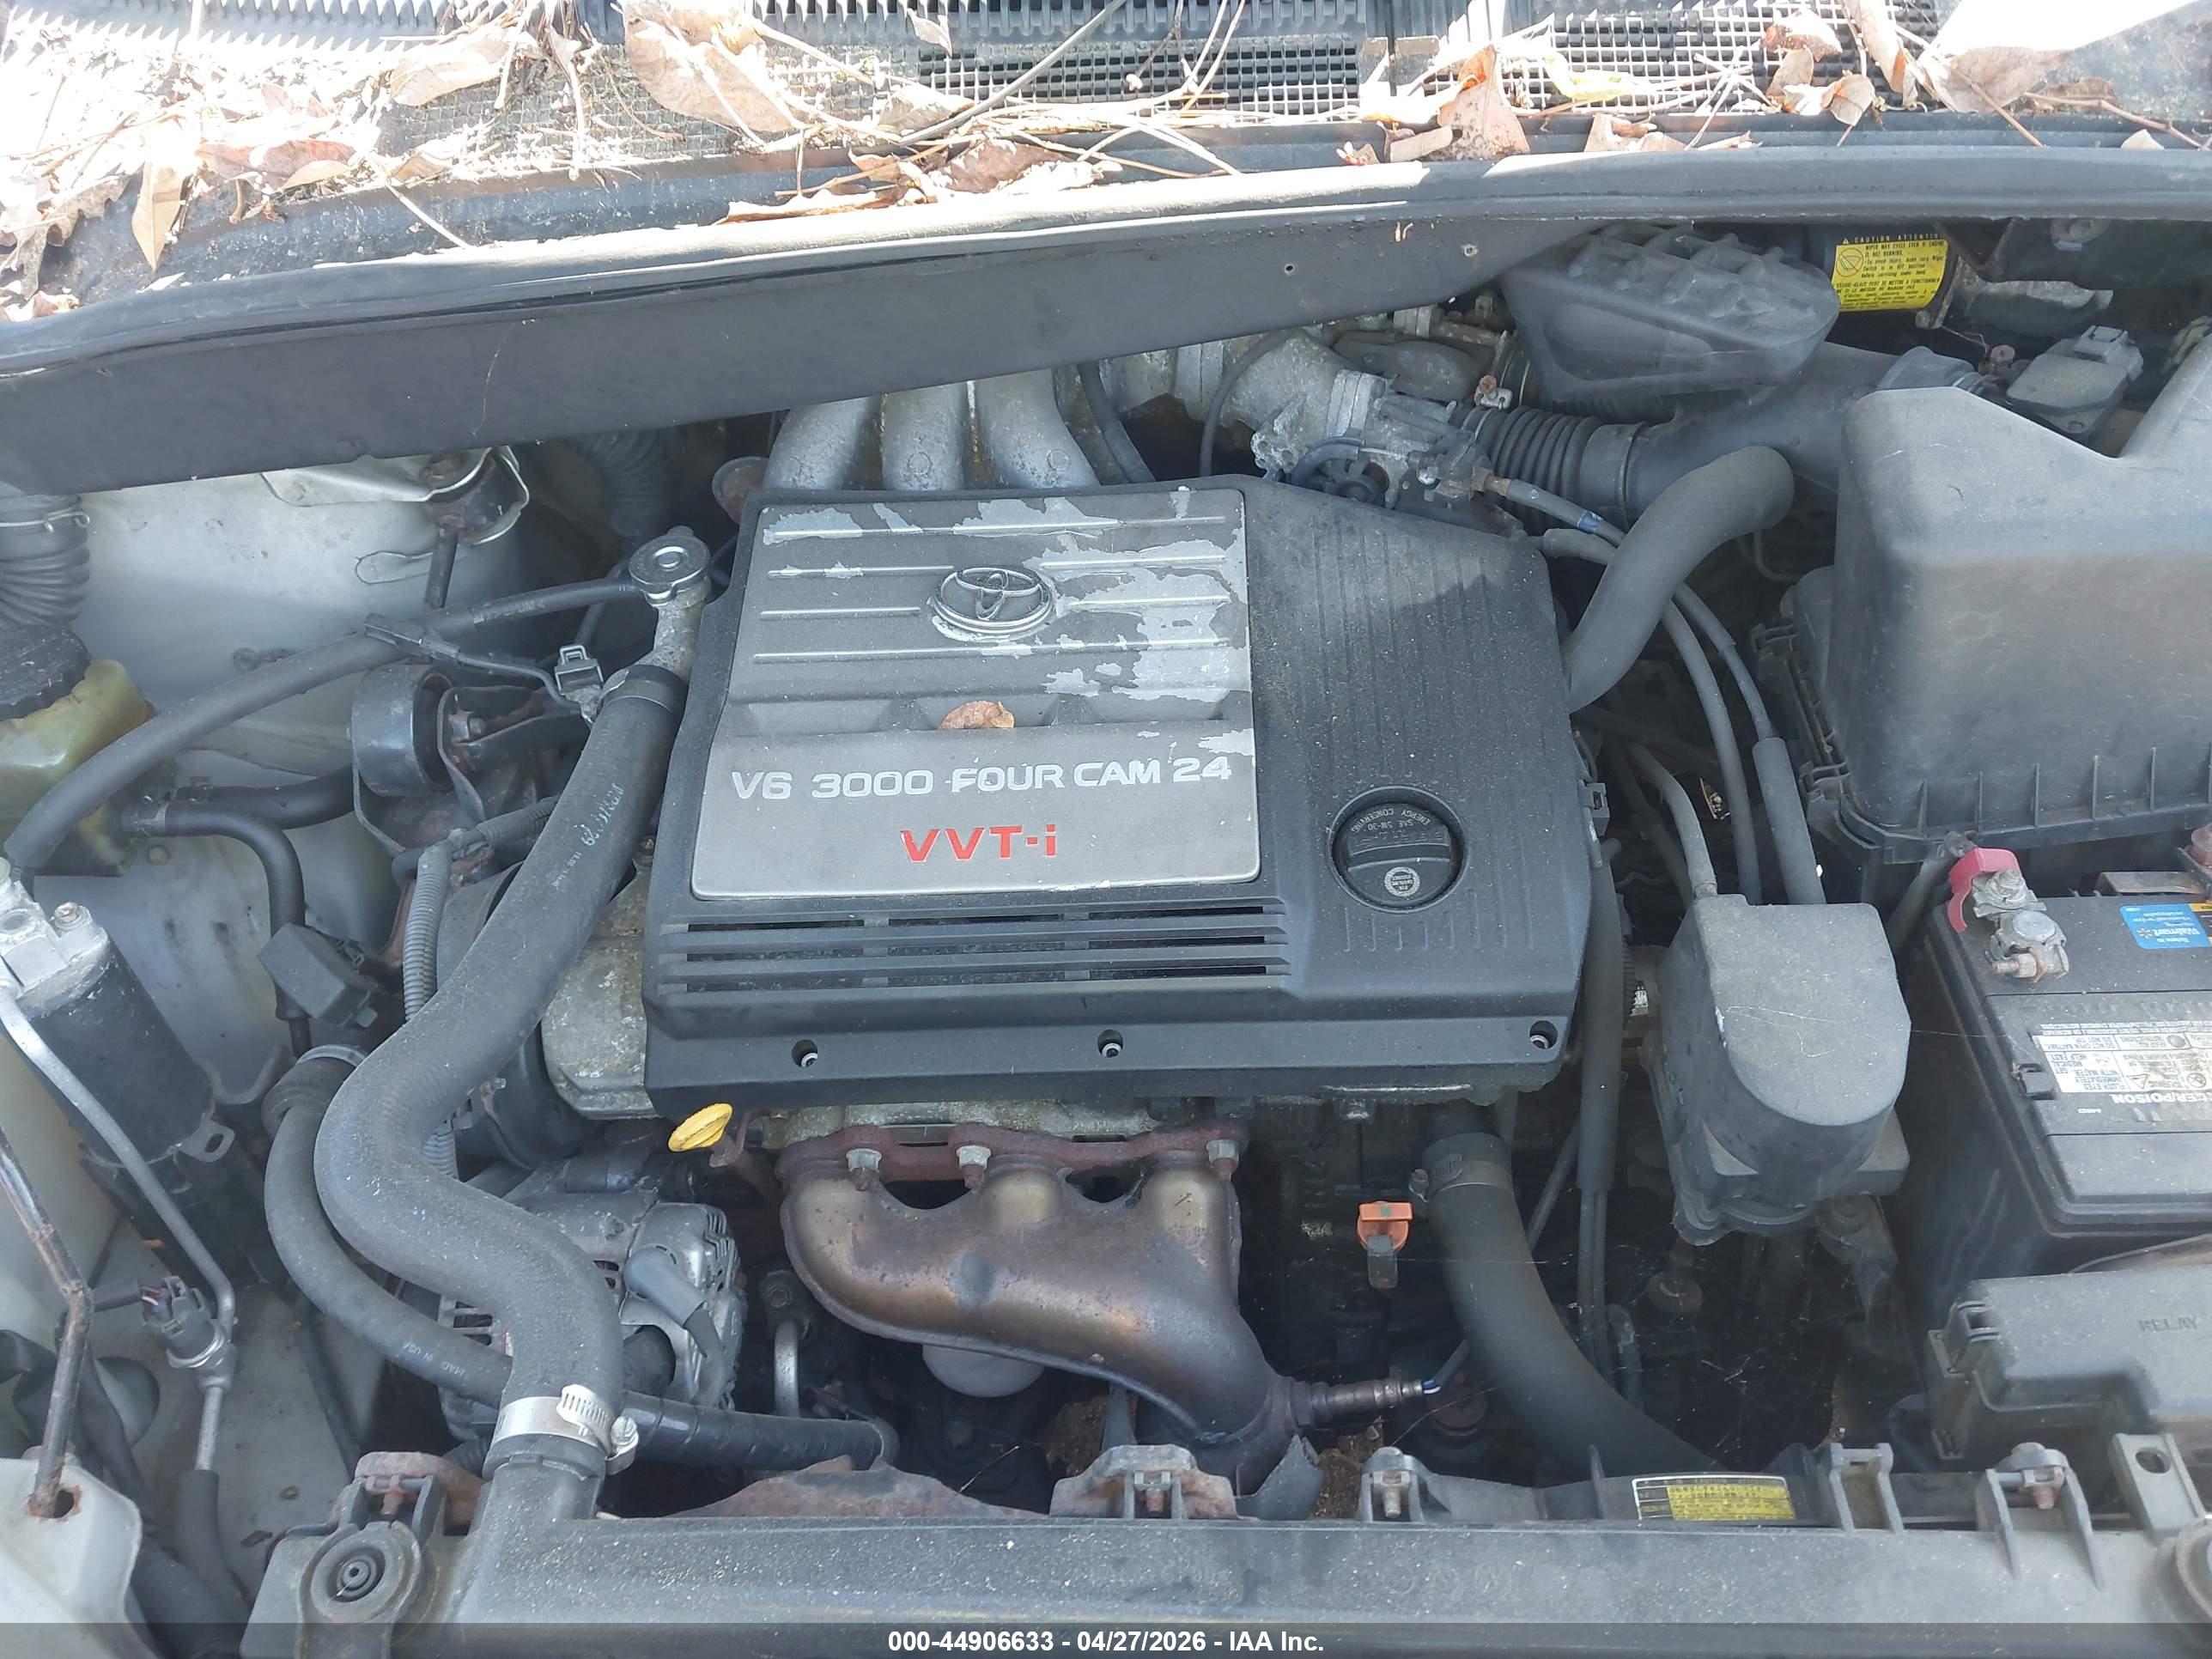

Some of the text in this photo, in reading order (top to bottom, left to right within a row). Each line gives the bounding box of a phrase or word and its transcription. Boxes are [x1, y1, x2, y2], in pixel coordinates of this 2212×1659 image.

[1855, 234, 1890, 243] CAUTION
[732, 756, 1232, 800] V6 3000 FOUR CAM 24
[1351, 808, 1431, 833] ENERGY CONSERVING
[1367, 821, 1393, 831] 5W-30
[899, 823, 1058, 863] VVT-i
[2152, 927, 2200, 936] Walmart
[2137, 1316, 2198, 1333] RELAY
